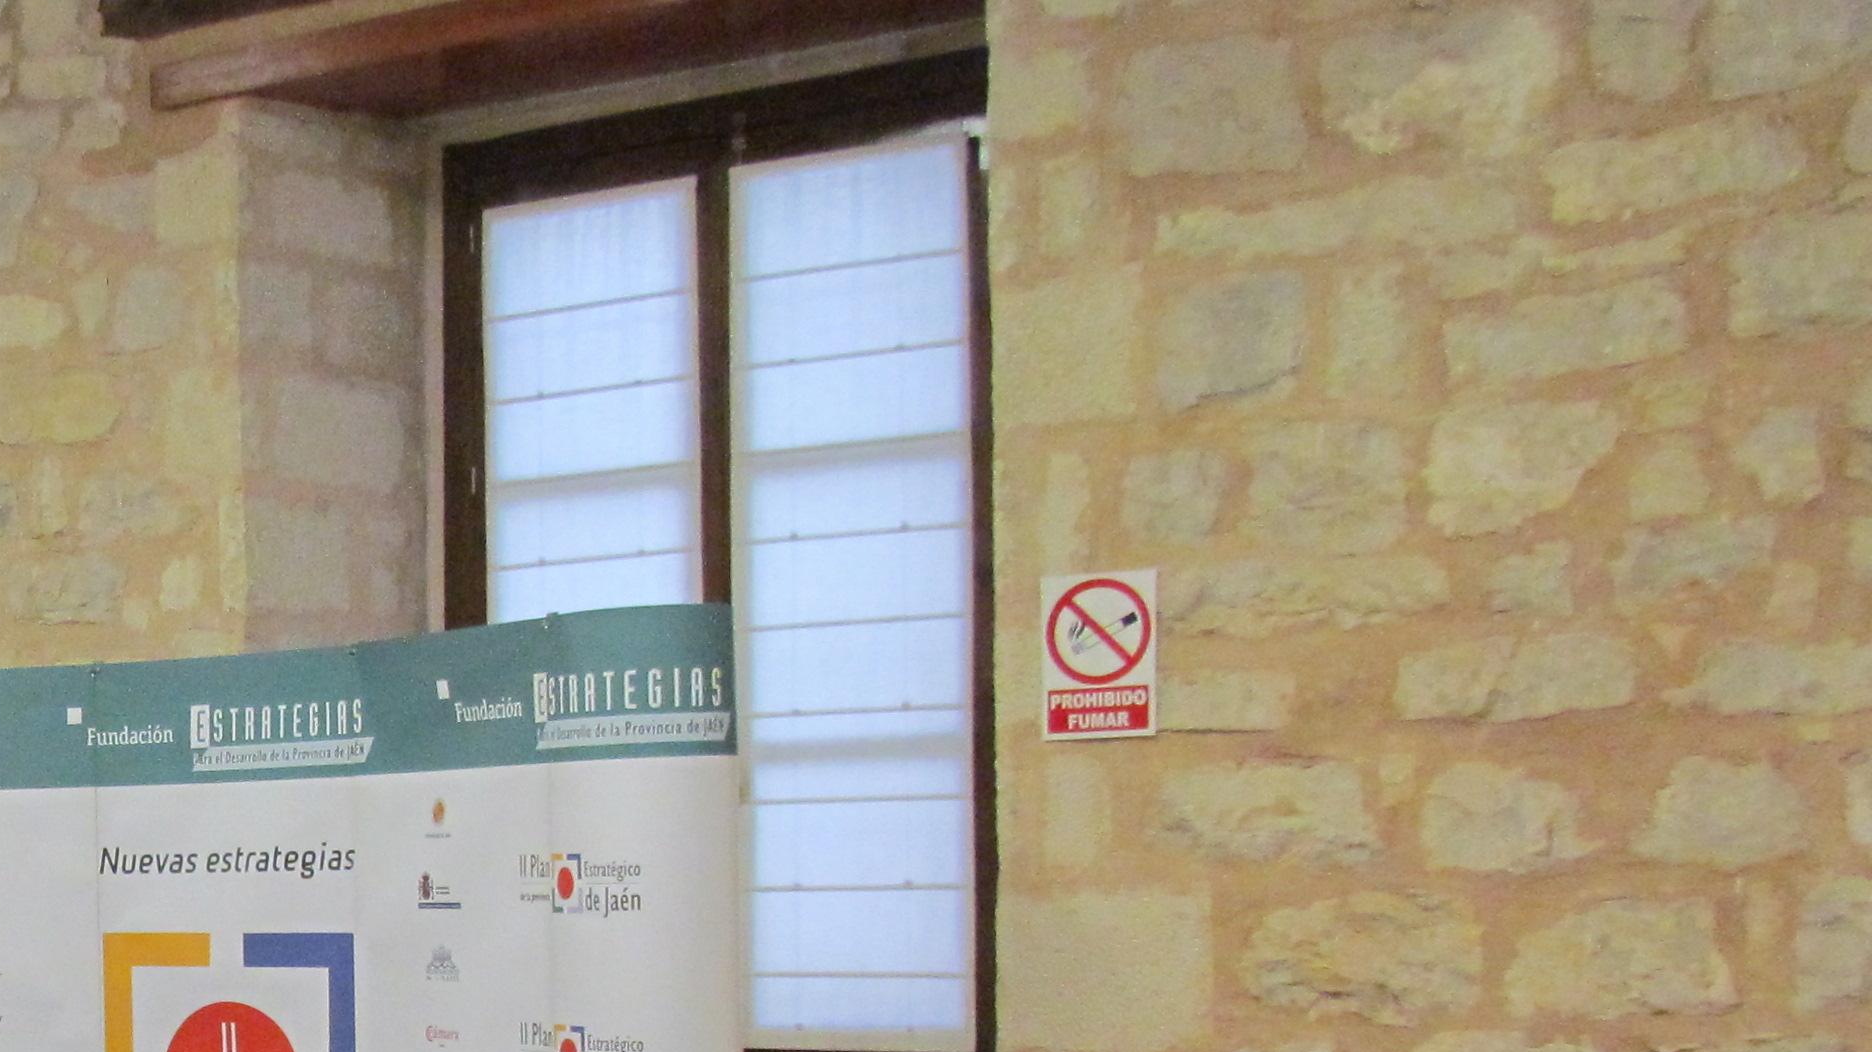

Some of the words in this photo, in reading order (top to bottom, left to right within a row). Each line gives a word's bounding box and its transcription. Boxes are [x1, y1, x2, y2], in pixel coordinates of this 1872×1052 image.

[455, 697, 522, 722] Fundación
[536, 668, 722, 721] ESTRATEGIAS
[1051, 690, 1147, 710] PROHIBIDO
[87, 725, 173, 746] Fundación
[192, 699, 362, 747] ESTRATEGIAS
[610, 723, 620, 736] la
[625, 720, 681, 736] Provincia
[686, 719, 699, 733] de
[1068, 711, 1129, 729] FUMAR
[225, 750, 266, 764] Desarrollo
[270, 748, 280, 761] de
[282, 747, 290, 760] la
[292, 746, 331, 760] Provincia
[334, 745, 344, 758] de
[99, 846, 198, 874] Nuevas
[206, 841, 356, 879] estrategias
[519, 855, 526, 877] II
[530, 854, 550, 877] Plan
[583, 860, 641, 881] Estratégico
[585, 887, 600, 911] de
[604, 887, 641, 918] Jaén
[520, 1022, 528, 1045] II
[532, 1022, 553, 1047] Plan
